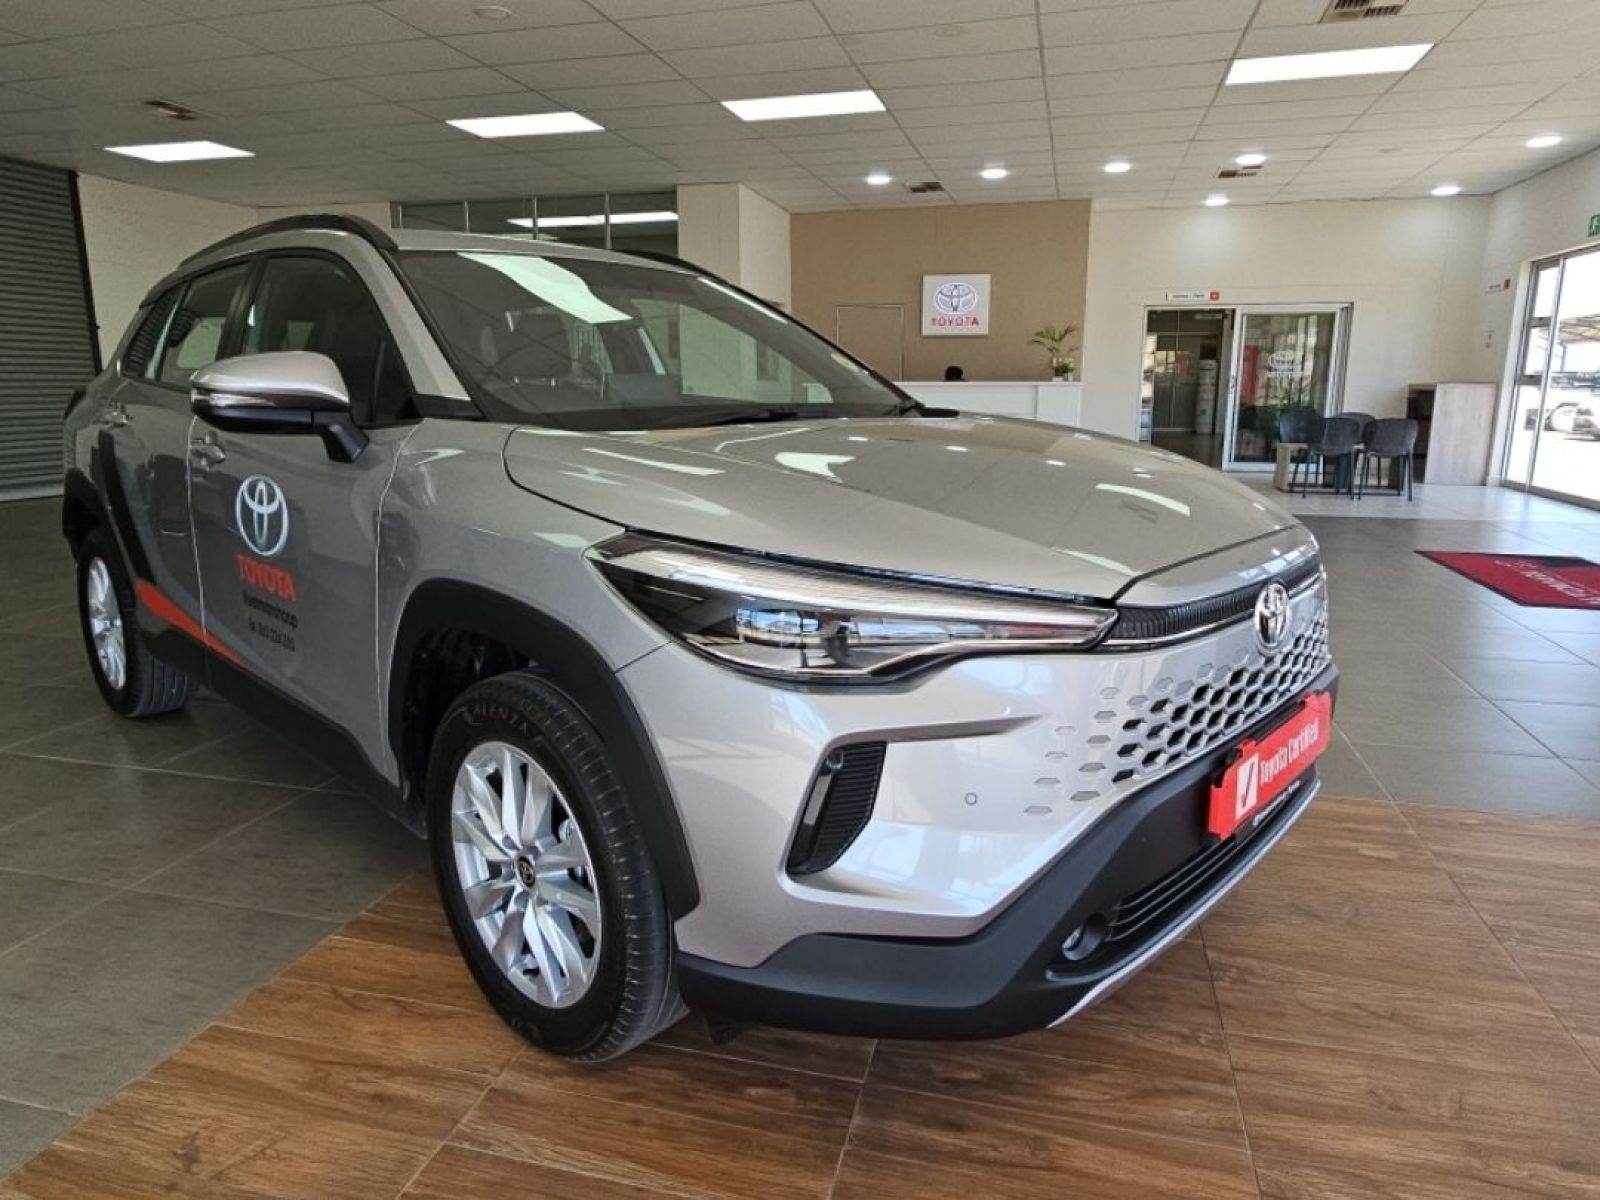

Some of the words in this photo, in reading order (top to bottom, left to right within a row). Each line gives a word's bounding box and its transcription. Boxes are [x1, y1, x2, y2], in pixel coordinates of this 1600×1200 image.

[931, 316, 979, 327] TOYOTA
[236, 554, 296, 601] TOYOTA
[1260, 746, 1288, 787] Toyota
